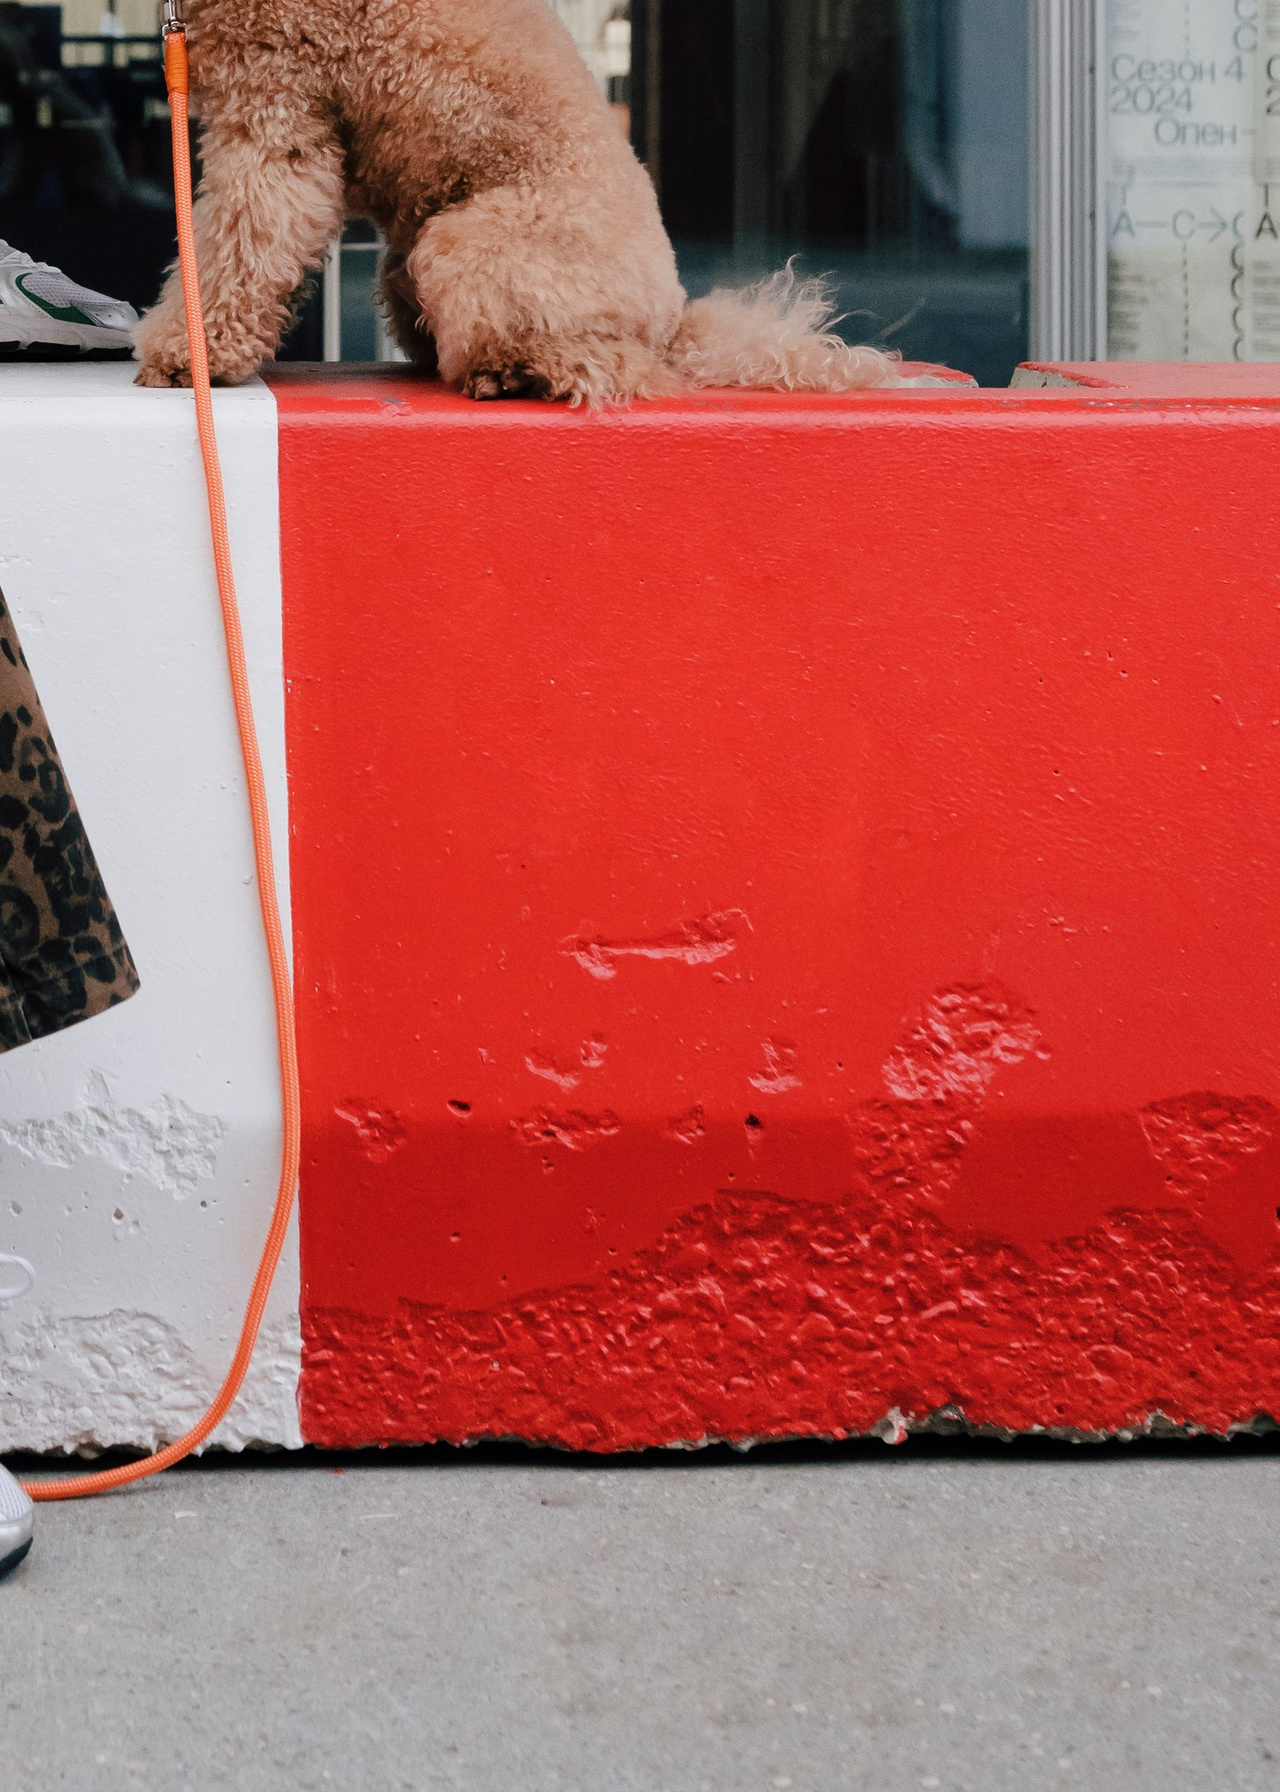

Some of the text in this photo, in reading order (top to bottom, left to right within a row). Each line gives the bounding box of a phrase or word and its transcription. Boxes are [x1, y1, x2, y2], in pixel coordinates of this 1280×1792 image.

[1110, 53, 1243, 83] Сезон 4
[1110, 84, 1193, 115] 2024
